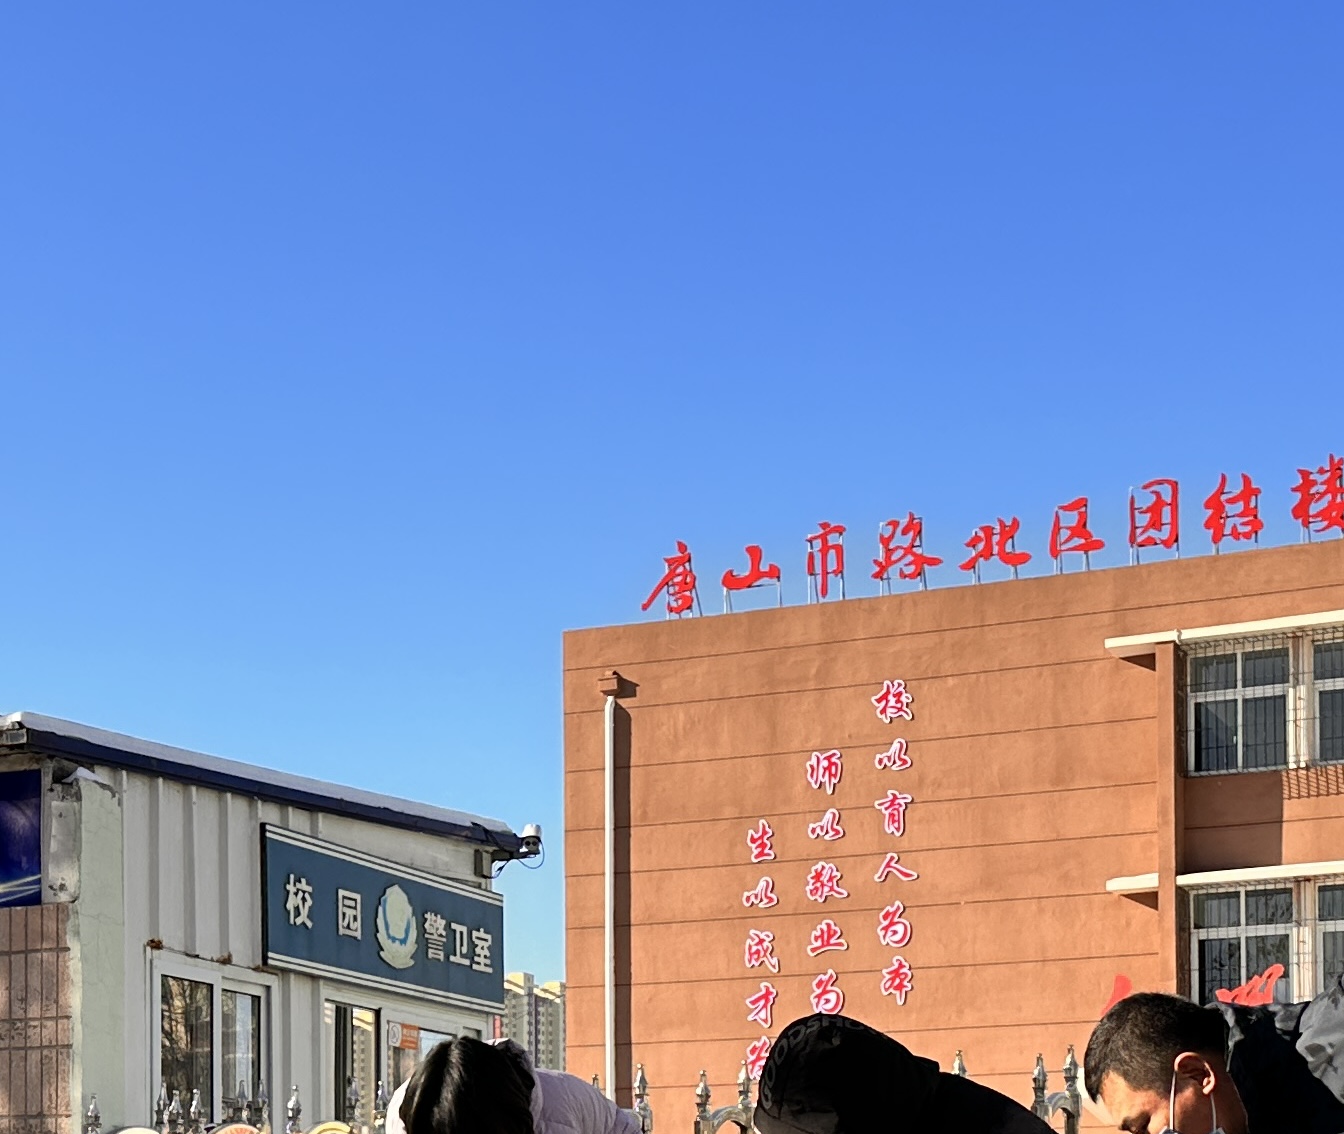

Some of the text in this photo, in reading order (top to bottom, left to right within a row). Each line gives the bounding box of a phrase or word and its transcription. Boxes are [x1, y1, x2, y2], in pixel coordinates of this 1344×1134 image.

[285, 873, 494, 974] 校园 警卫室
[742, 819, 780, 1084] 生以成才为
[872, 679, 918, 1005] 校以育人为本
